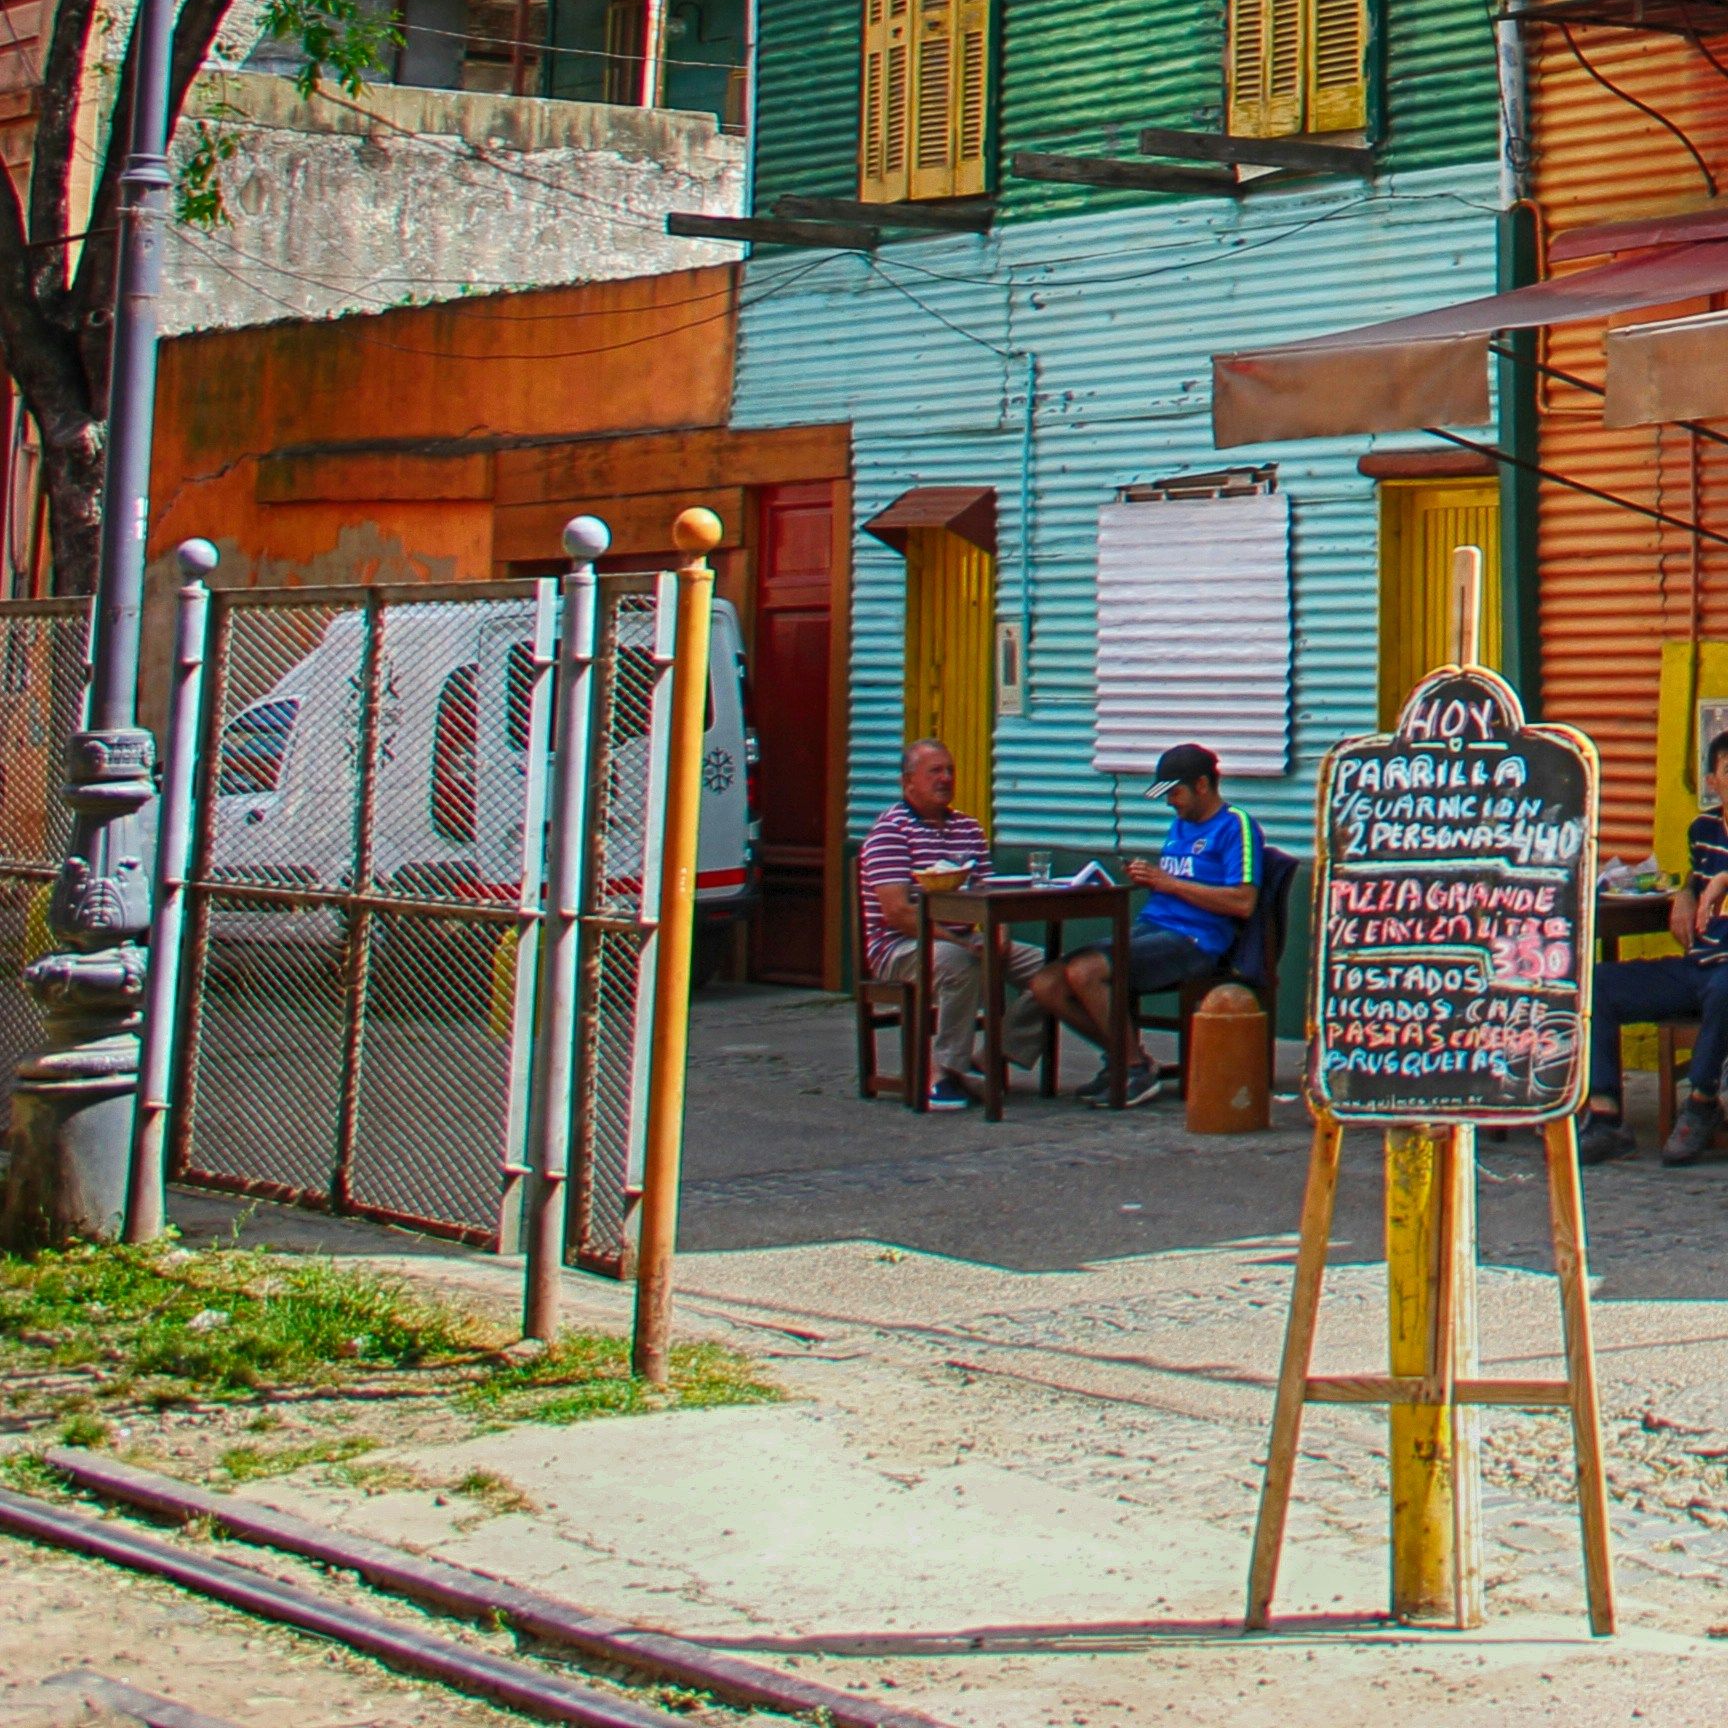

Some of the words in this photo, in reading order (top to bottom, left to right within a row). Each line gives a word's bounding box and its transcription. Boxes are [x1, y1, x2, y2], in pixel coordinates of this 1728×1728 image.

[1406, 698, 1493, 740] HOY
[1334, 754, 1527, 795] PARRILLA
[1344, 822, 1367, 856] 2
[1371, 823, 1513, 851] PERSONAS
[1512, 818, 1583, 864] 440
[1330, 878, 1422, 915] PIZZA
[1426, 881, 1557, 913] GRANDE
[1330, 964, 1488, 995] TOSTADOS
[1325, 997, 1454, 1021] LICUADOS
[1327, 1022, 1446, 1053] PASTAS
